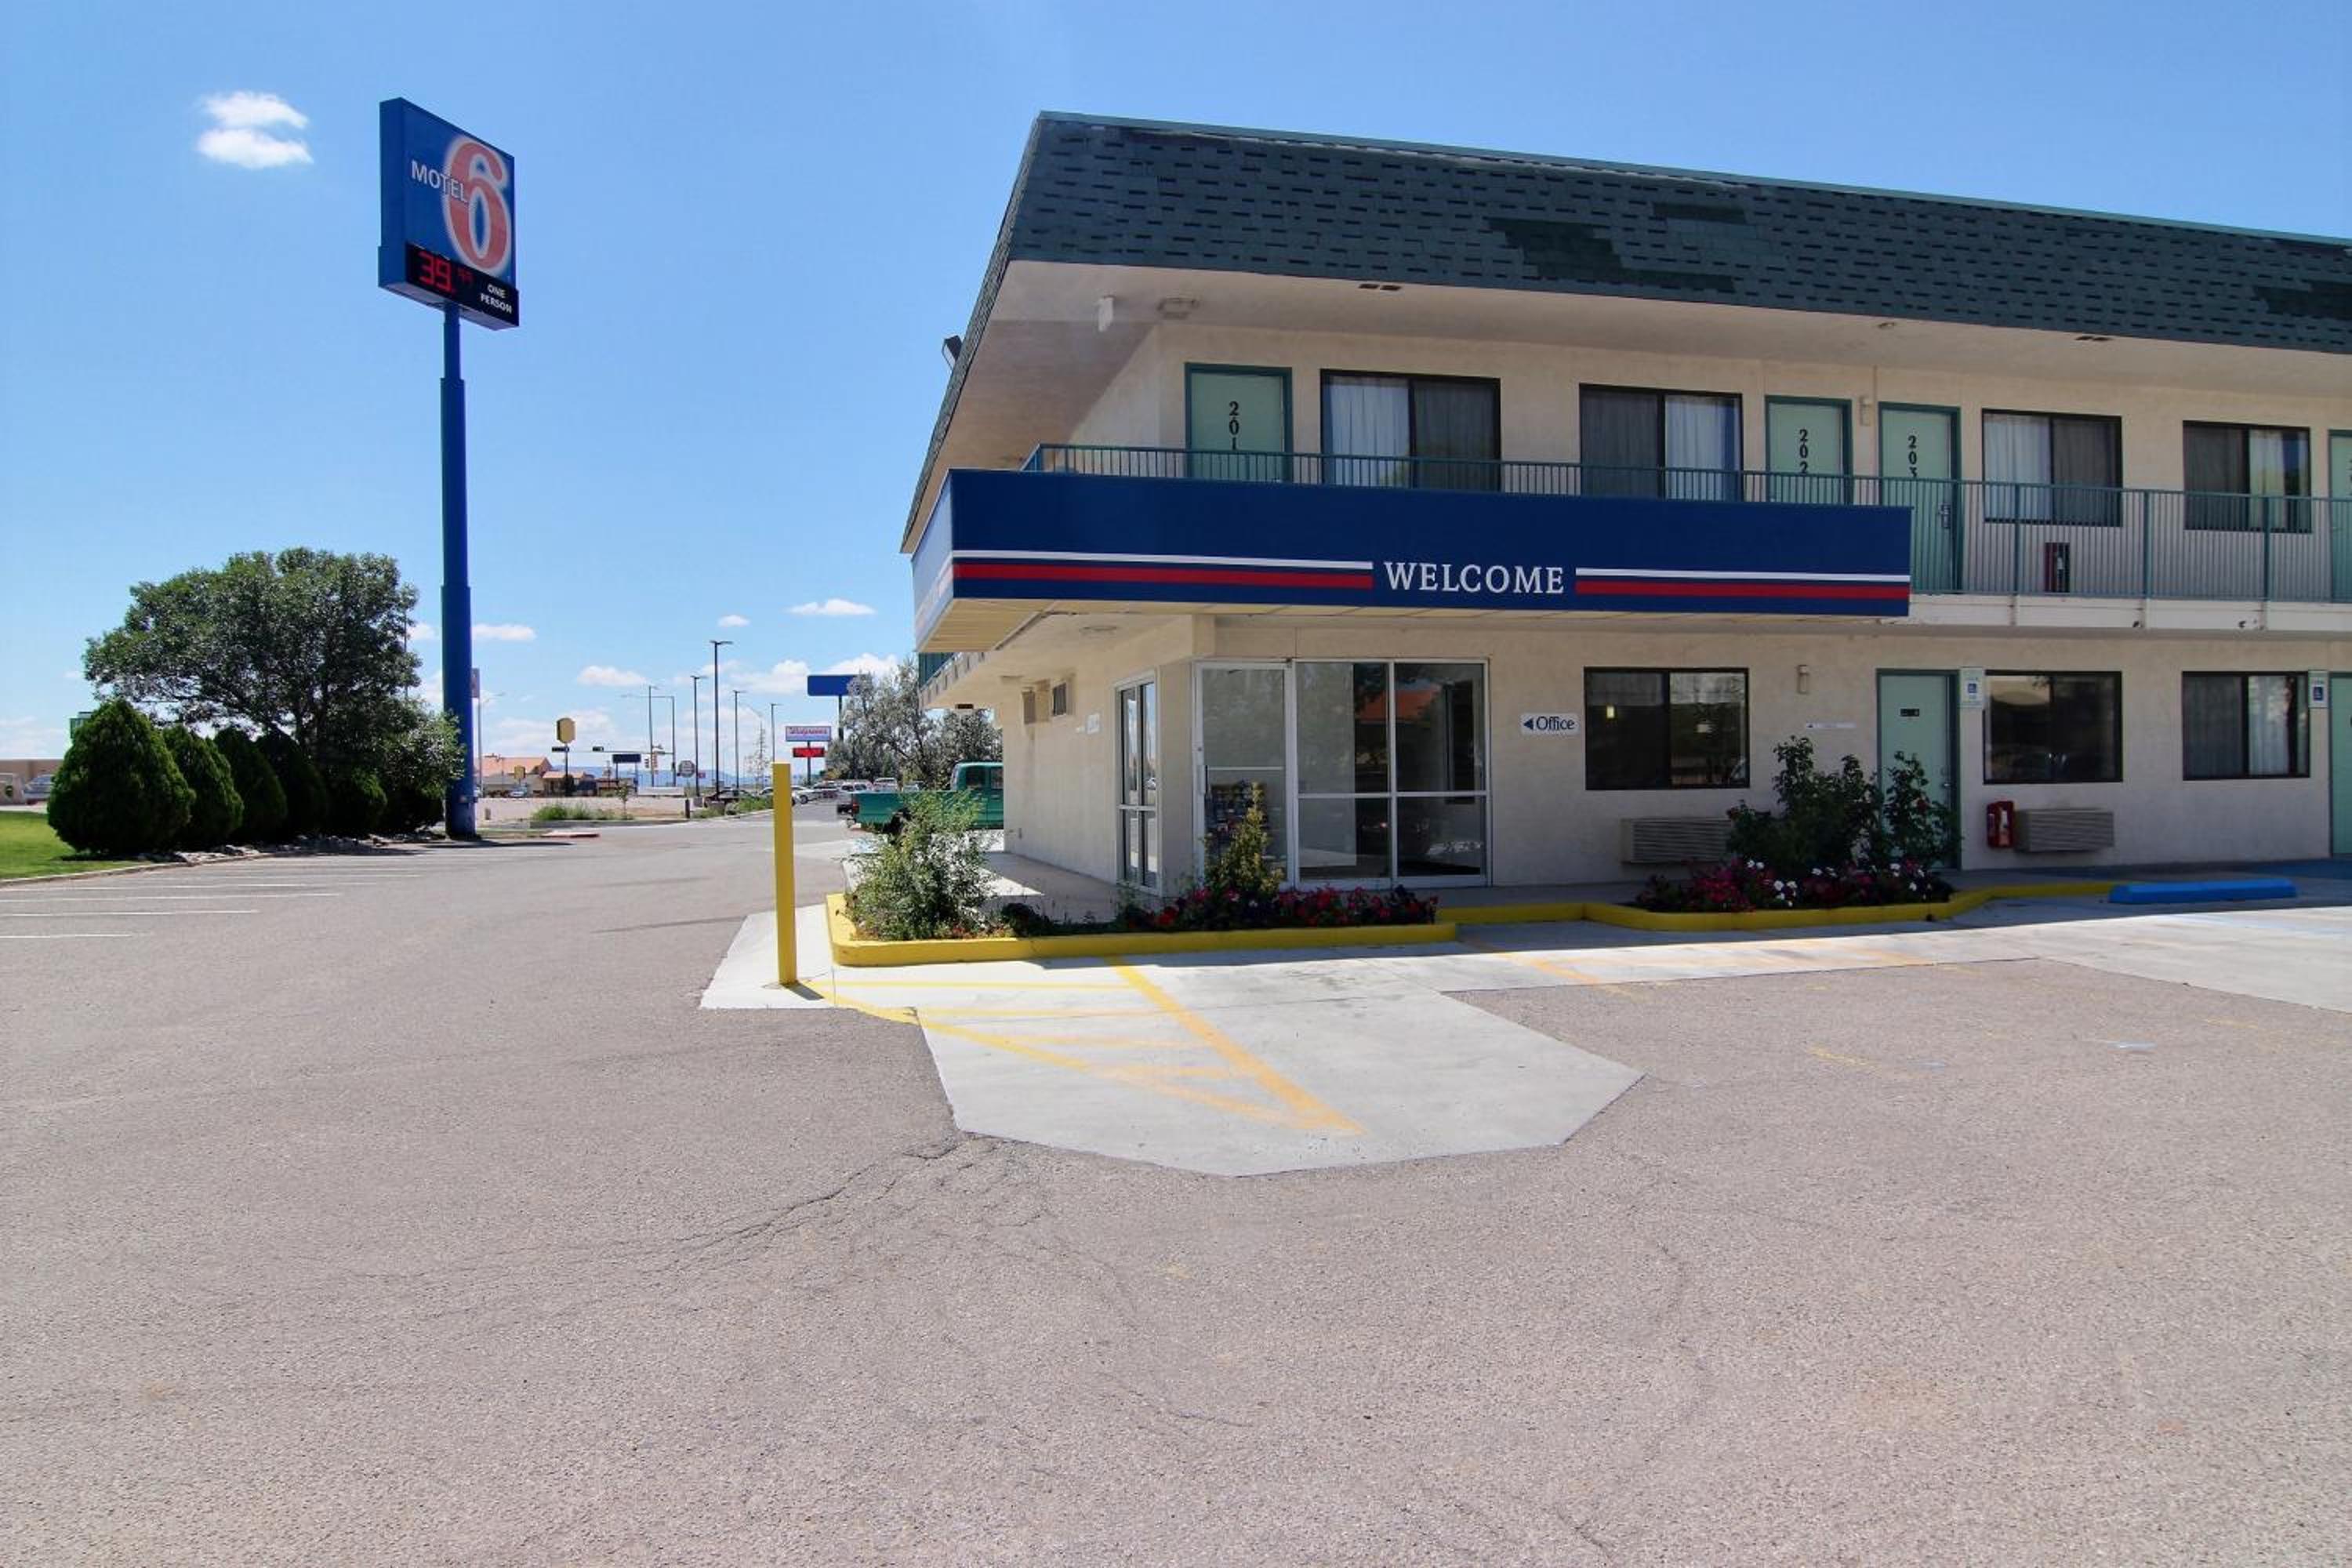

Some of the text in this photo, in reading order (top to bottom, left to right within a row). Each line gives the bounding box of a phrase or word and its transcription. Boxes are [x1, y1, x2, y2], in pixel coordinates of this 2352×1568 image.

[411, 136, 511, 274] MOTEL 6
[418, 250, 452, 294] 39
[487, 283, 507, 299] ONE
[480, 292, 513, 314] PERSON
[1229, 401, 1240, 451] 201
[1799, 428, 1809, 474] 202
[1383, 561, 1564, 593] WELCOME
[1537, 716, 1575, 731] Office
